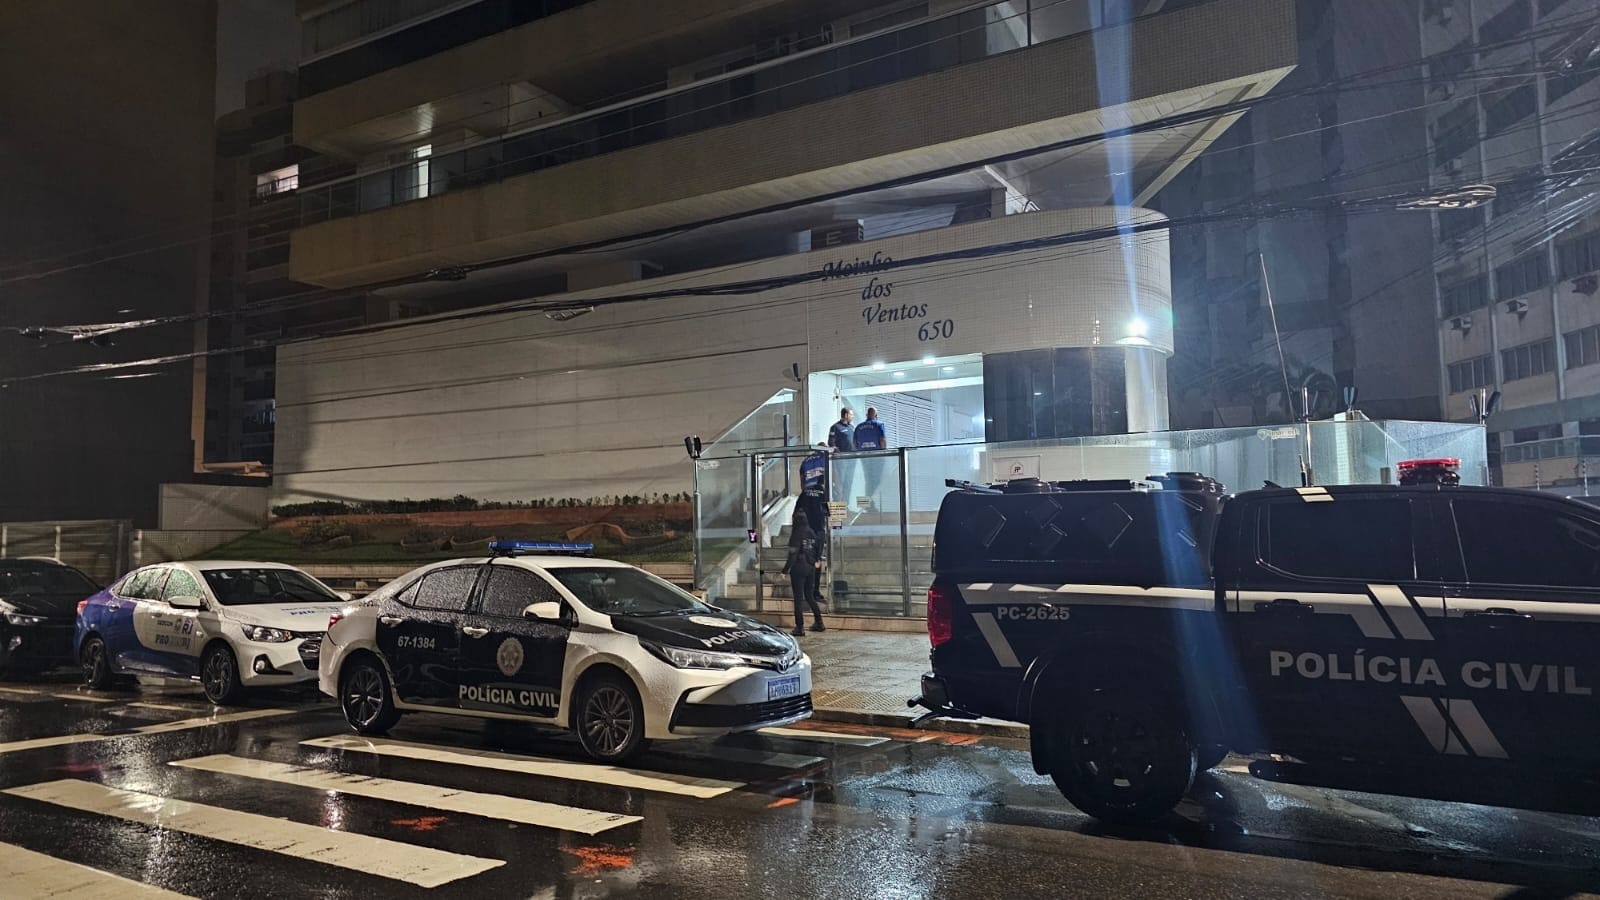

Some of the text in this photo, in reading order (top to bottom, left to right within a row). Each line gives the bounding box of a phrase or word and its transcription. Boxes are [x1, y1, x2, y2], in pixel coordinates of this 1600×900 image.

[862, 277, 893, 300] dos
[862, 303, 929, 325] Ventos
[918, 319, 954, 341] 650
[997, 606, 1071, 621] PC-2625
[397, 635, 436, 649] 67-1384
[700, 630, 754, 648] POLÍCI
[1269, 648, 1593, 696] POLÍCIA CIVIL
[458, 684, 560, 709] POLÍCIA CIVIL
